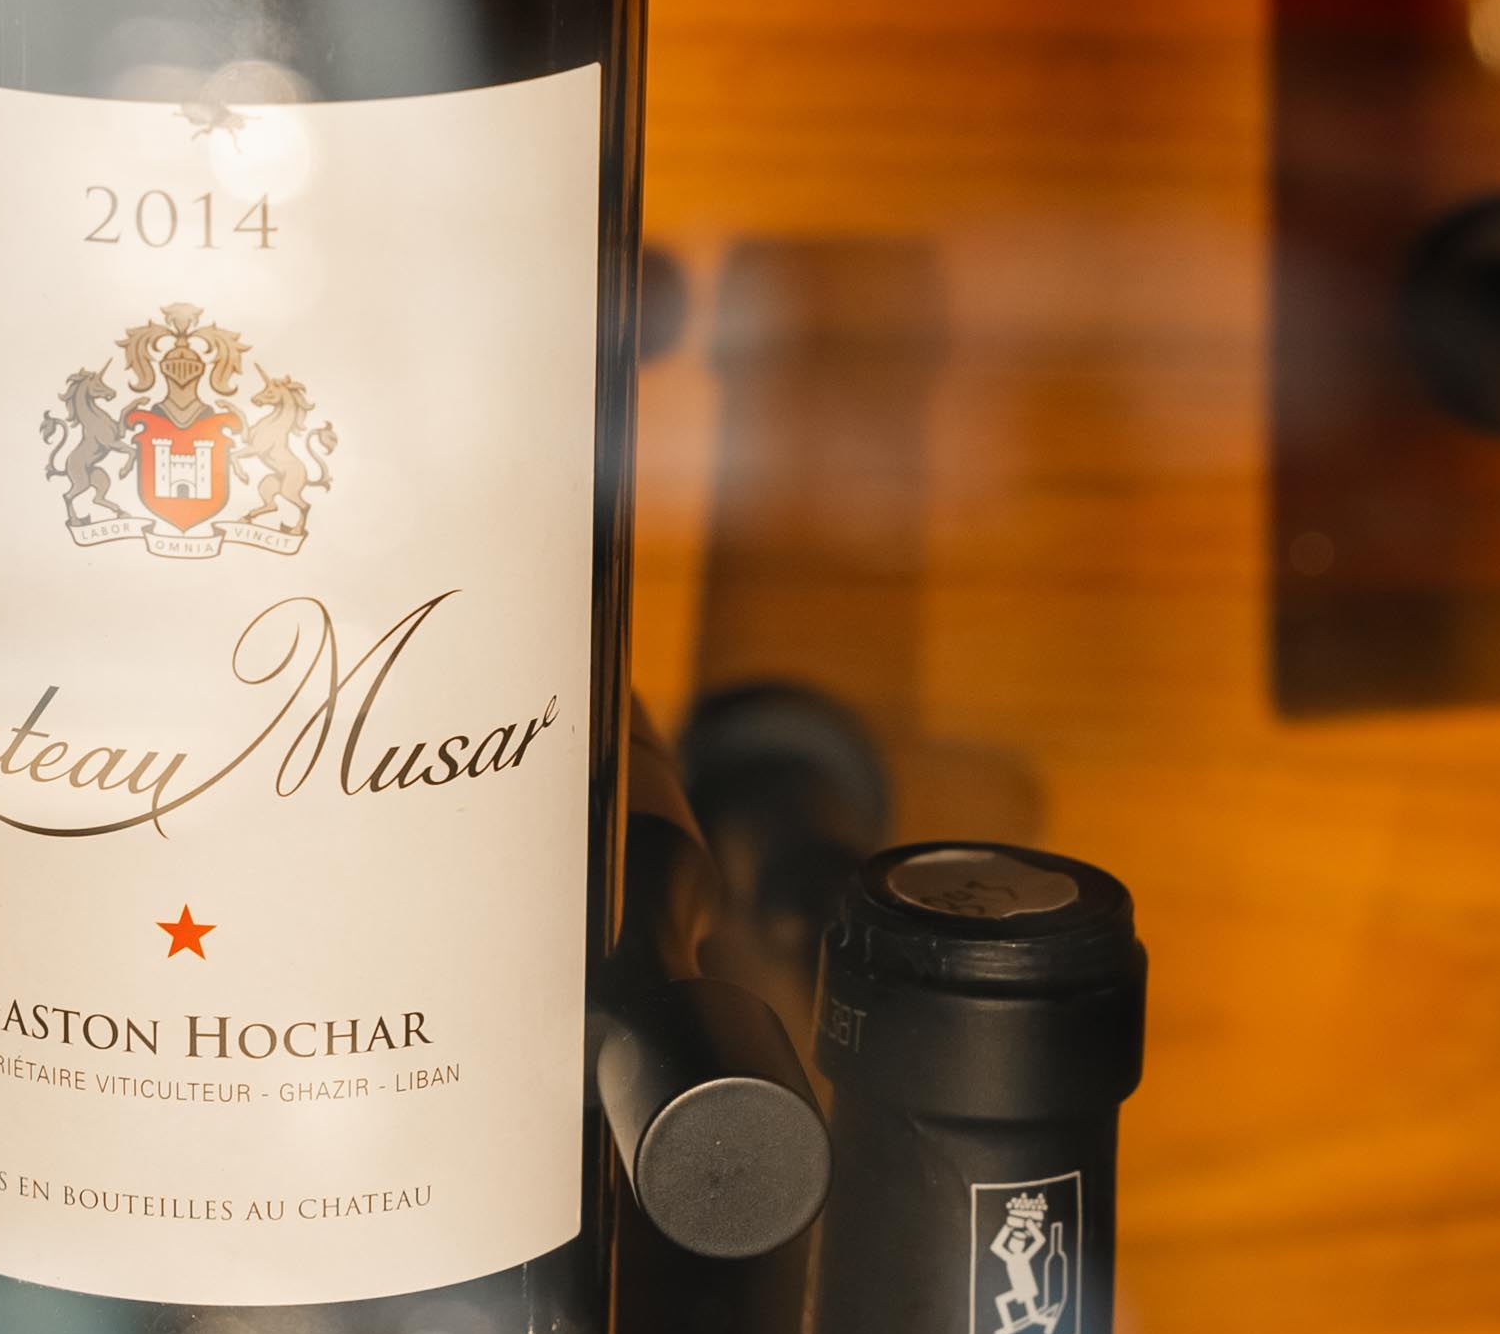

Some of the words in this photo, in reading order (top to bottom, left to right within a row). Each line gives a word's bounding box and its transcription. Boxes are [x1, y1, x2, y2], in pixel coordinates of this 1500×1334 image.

[83, 184, 280, 250] 2014
[80, 522, 131, 541] LABOR
[155, 540, 215, 555] OMNIA
[234, 527, 292, 549] VINCIT
[231, 589, 562, 798] Musar
[187, 1010, 435, 1060] HOCHAR
[96, 1071, 252, 1105] VITICULTEUR
[278, 1076, 370, 1104] GHAZIR
[395, 1063, 462, 1095] LIBAN
[18, 1175, 51, 1203] EN
[62, 1185, 233, 1223] BOUTEILLES
[245, 1198, 285, 1223] AU
[297, 1184, 434, 1221] CHATEAU
